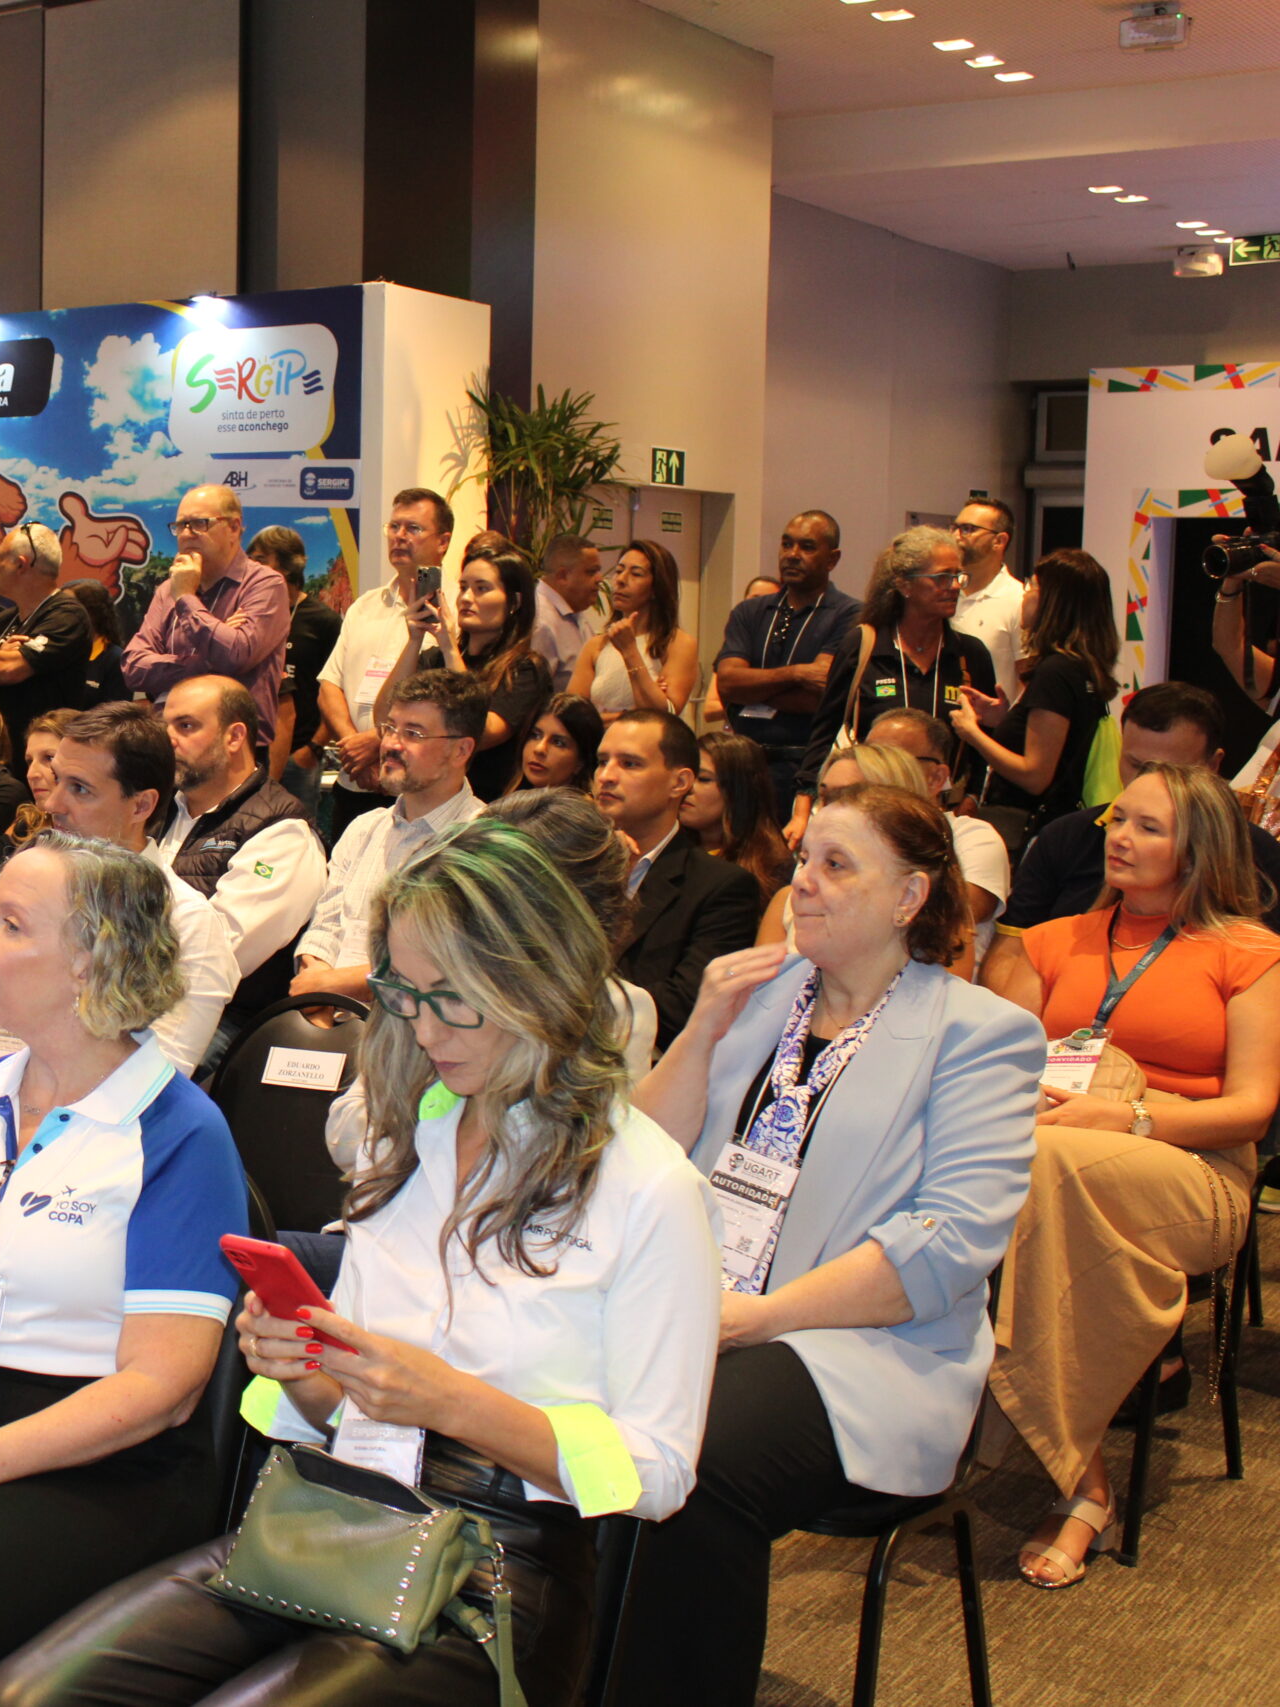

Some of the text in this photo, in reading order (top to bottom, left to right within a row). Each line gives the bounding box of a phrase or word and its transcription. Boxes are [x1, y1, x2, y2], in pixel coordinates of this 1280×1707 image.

[222, 408, 285, 422] sinta de perto
[217, 420, 289, 433] esse aconchego
[287, 1061, 321, 1071] EDUARDO
[742, 1161, 782, 1181] UGART
[711, 1174, 779, 1208] AUTORIDADE
[71, 1201, 97, 1214] SOY
[48, 1210, 84, 1225] COPA
